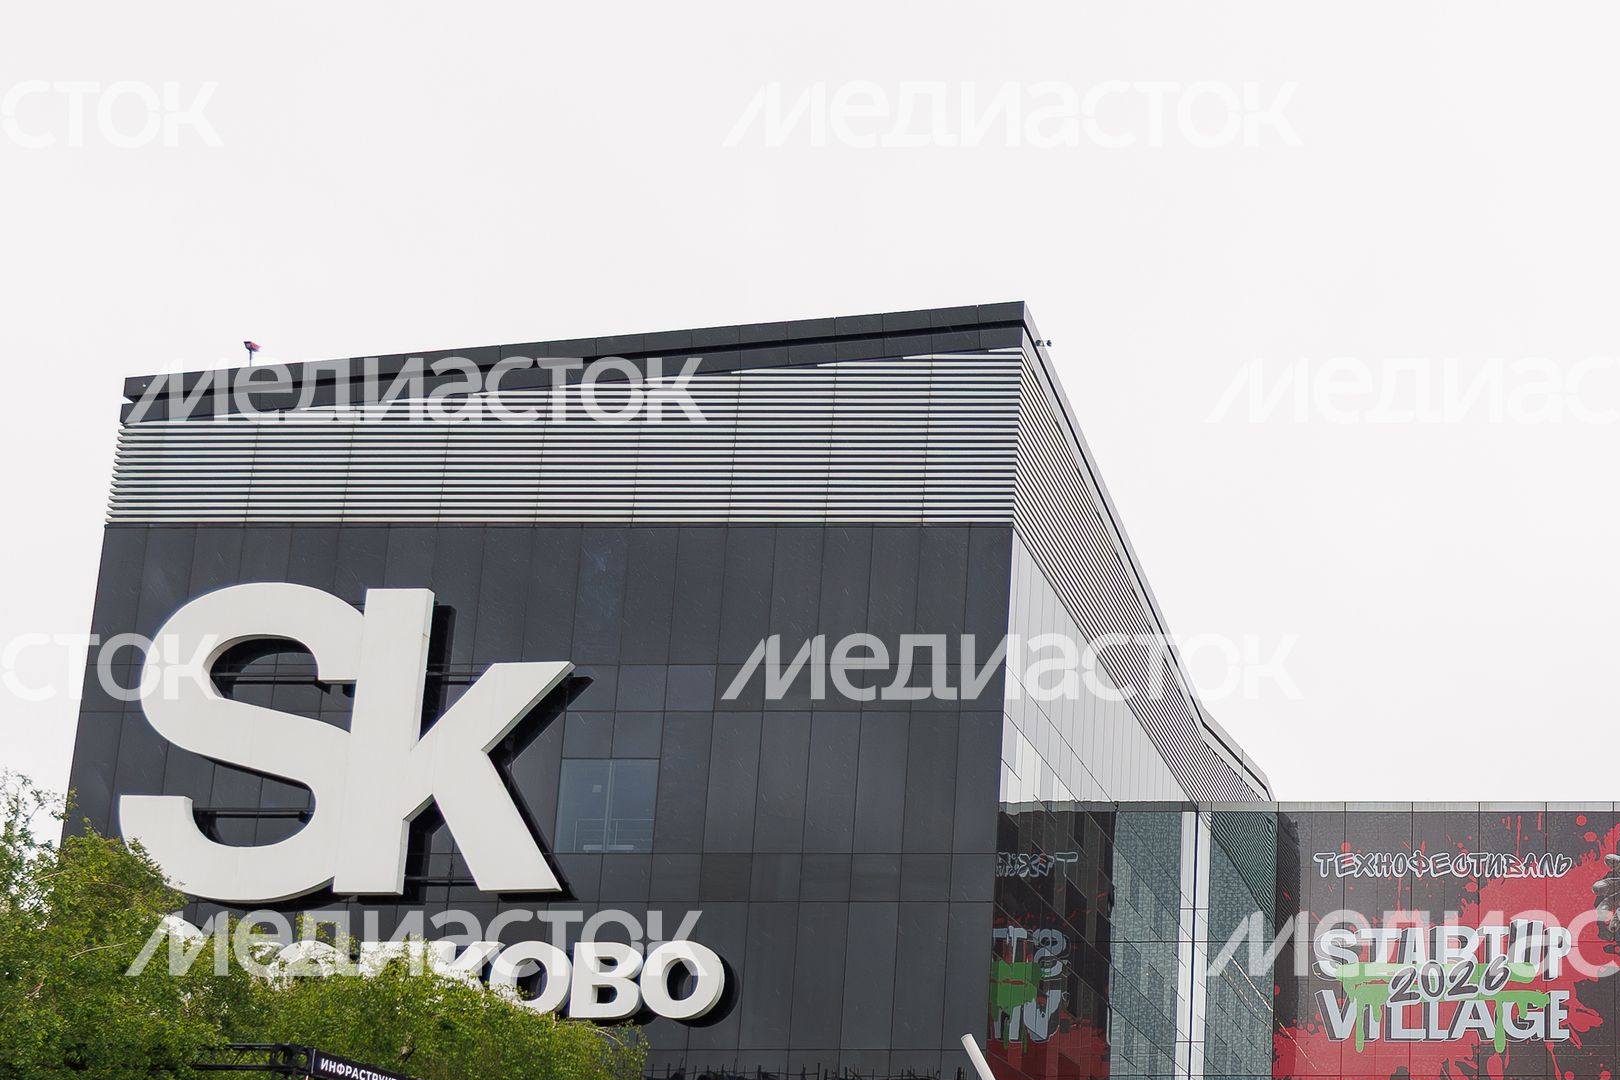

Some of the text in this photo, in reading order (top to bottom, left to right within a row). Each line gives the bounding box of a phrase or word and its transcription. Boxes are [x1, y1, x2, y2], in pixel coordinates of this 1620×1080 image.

[118, 582, 574, 903] Sk
[1312, 850, 1573, 878] ТЕХНОФЕСТИВАЛЬ
[164, 914, 726, 1020] ково
[1312, 919, 1571, 981] STARTUP
[1387, 954, 1510, 1004] 2026
[1314, 989, 1570, 1042] VILLAGE
